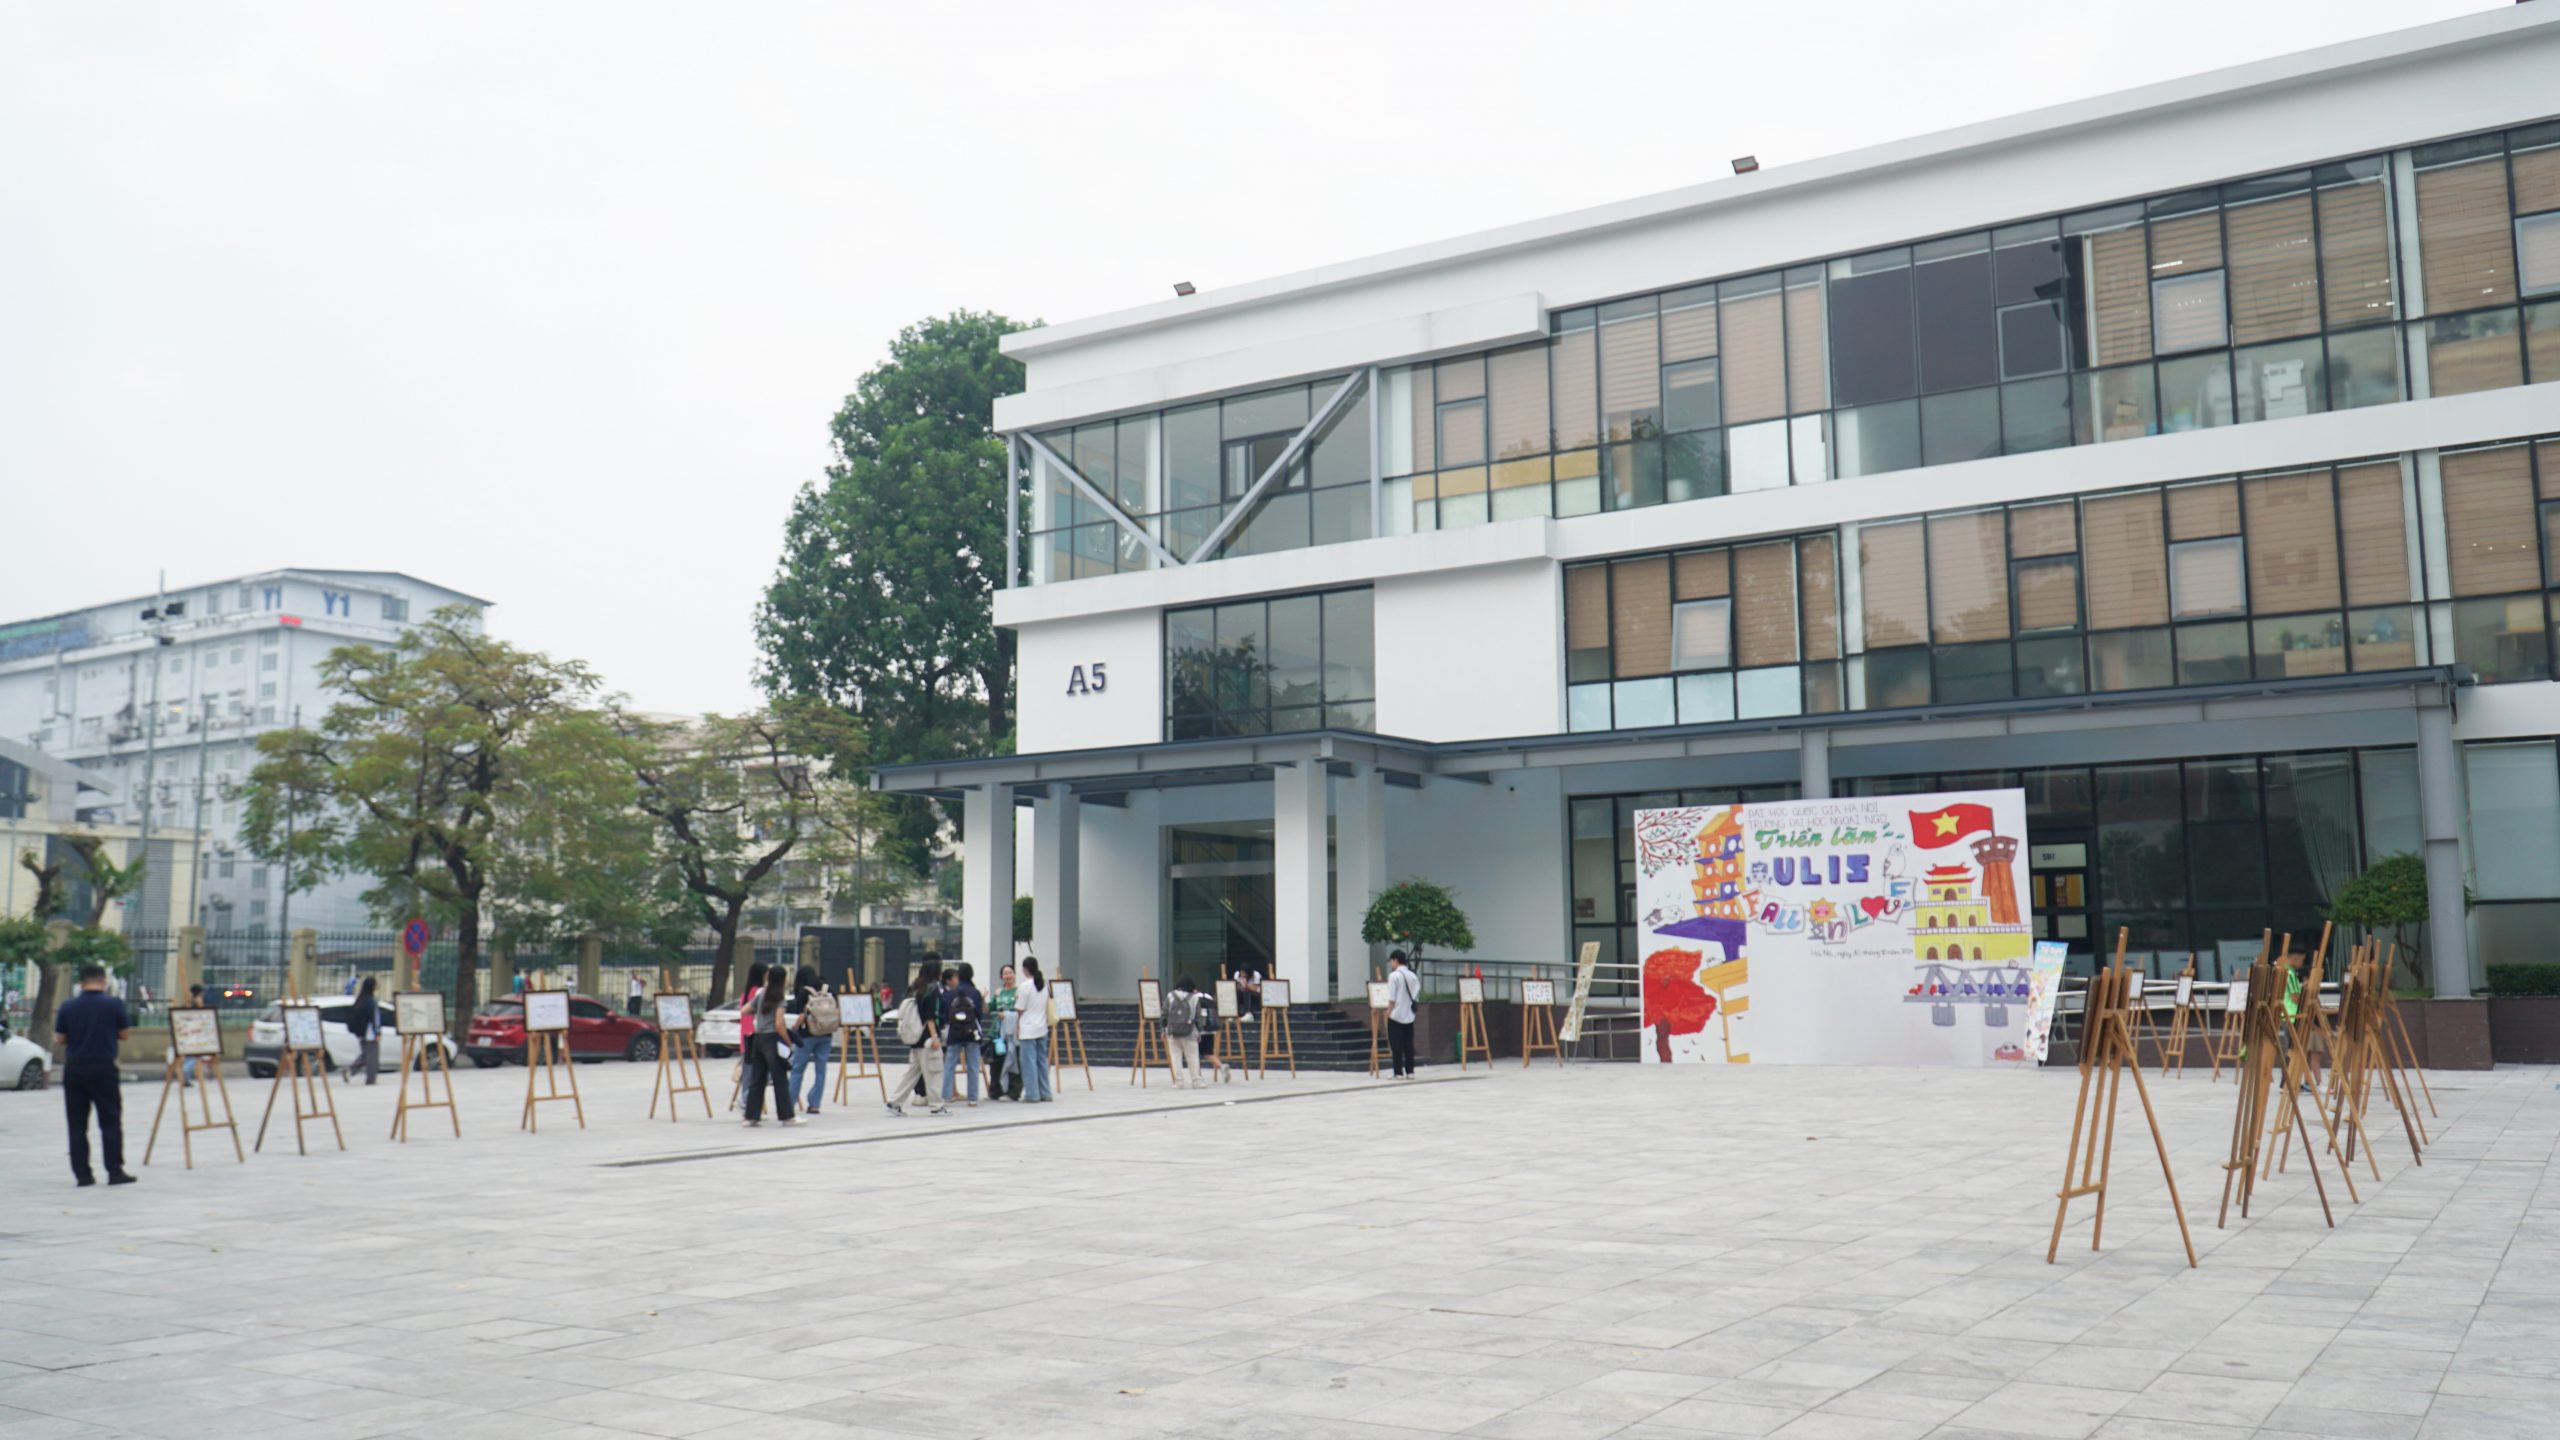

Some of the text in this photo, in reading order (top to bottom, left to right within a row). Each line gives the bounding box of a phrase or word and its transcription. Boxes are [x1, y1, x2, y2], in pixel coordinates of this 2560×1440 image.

[323, 590, 350, 617] Y1
[1066, 662, 1107, 697] A5
[1773, 854, 1870, 886] ULIS
